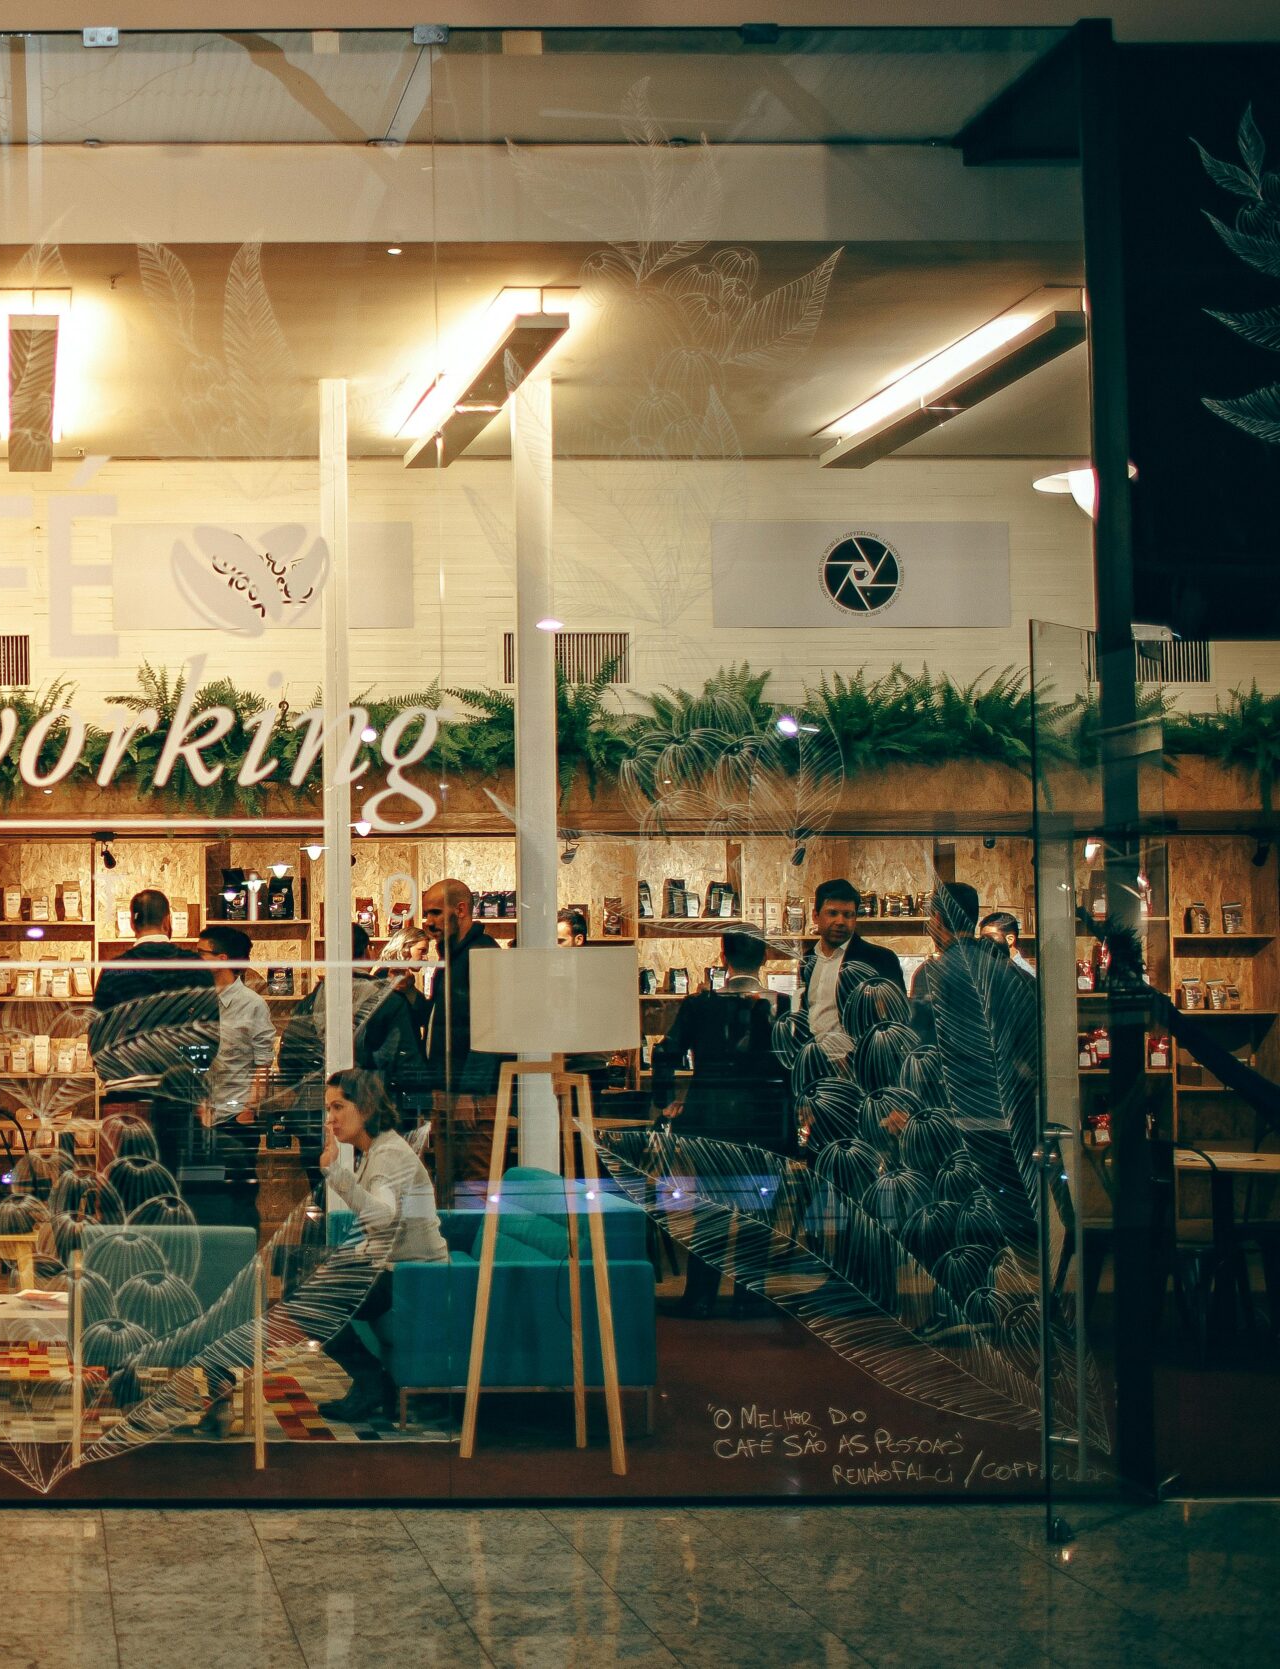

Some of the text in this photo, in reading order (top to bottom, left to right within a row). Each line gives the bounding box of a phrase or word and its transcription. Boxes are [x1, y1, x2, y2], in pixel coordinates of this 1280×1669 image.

[1185, 989, 1194, 1010] MITO
[1211, 989, 1221, 1010] MITO
[828, 1407, 867, 1424] DO
[713, 1432, 773, 1459] CAFÉ
[783, 1430, 827, 1457] SÃO
[838, 1434, 869, 1456] AS
